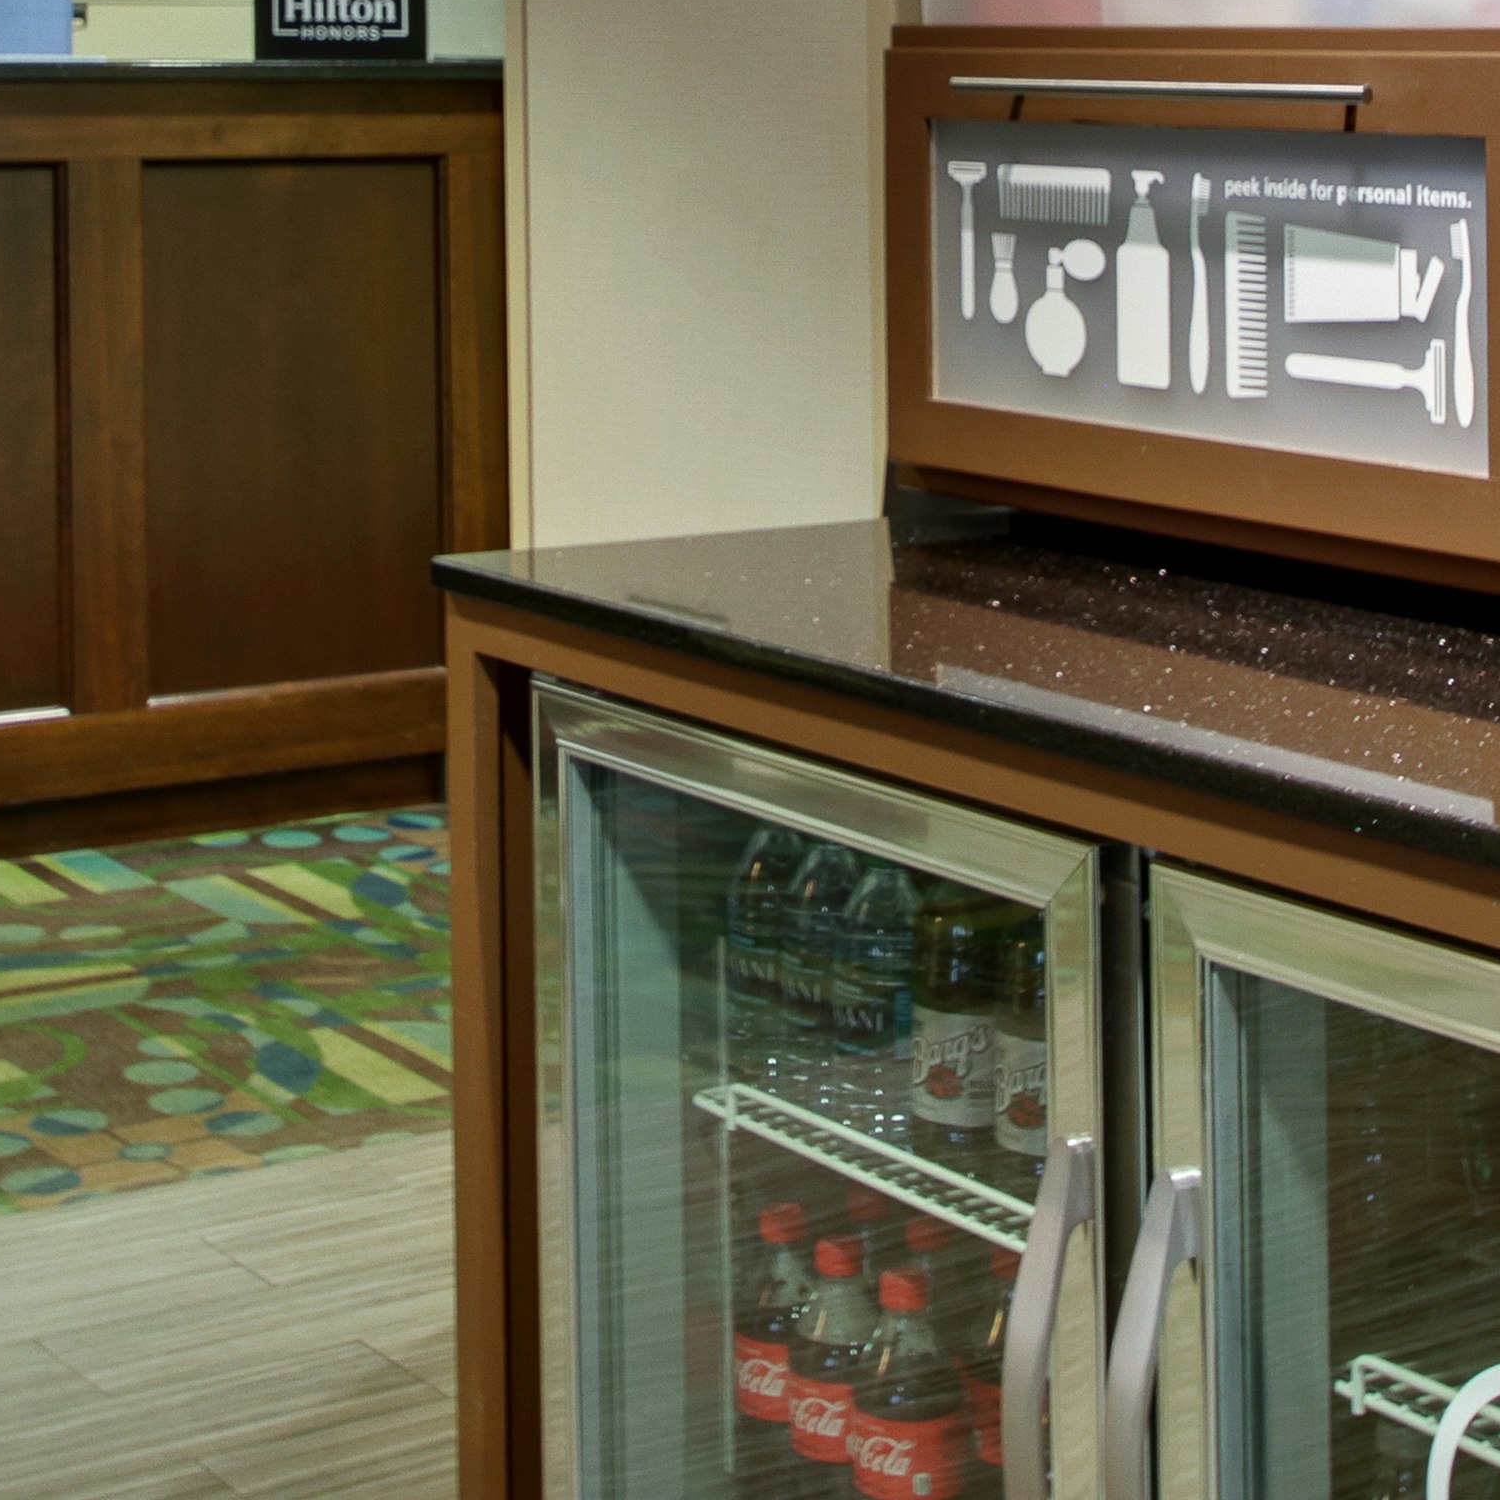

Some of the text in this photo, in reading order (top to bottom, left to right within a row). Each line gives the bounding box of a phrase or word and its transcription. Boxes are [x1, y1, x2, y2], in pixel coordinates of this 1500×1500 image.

[300, 24, 382, 42] HONORS
[1224, 176, 1261, 200] peek
[1263, 176, 1307, 200] inside
[1311, 179, 1334, 201] for
[1416, 183, 1473, 209] items.
